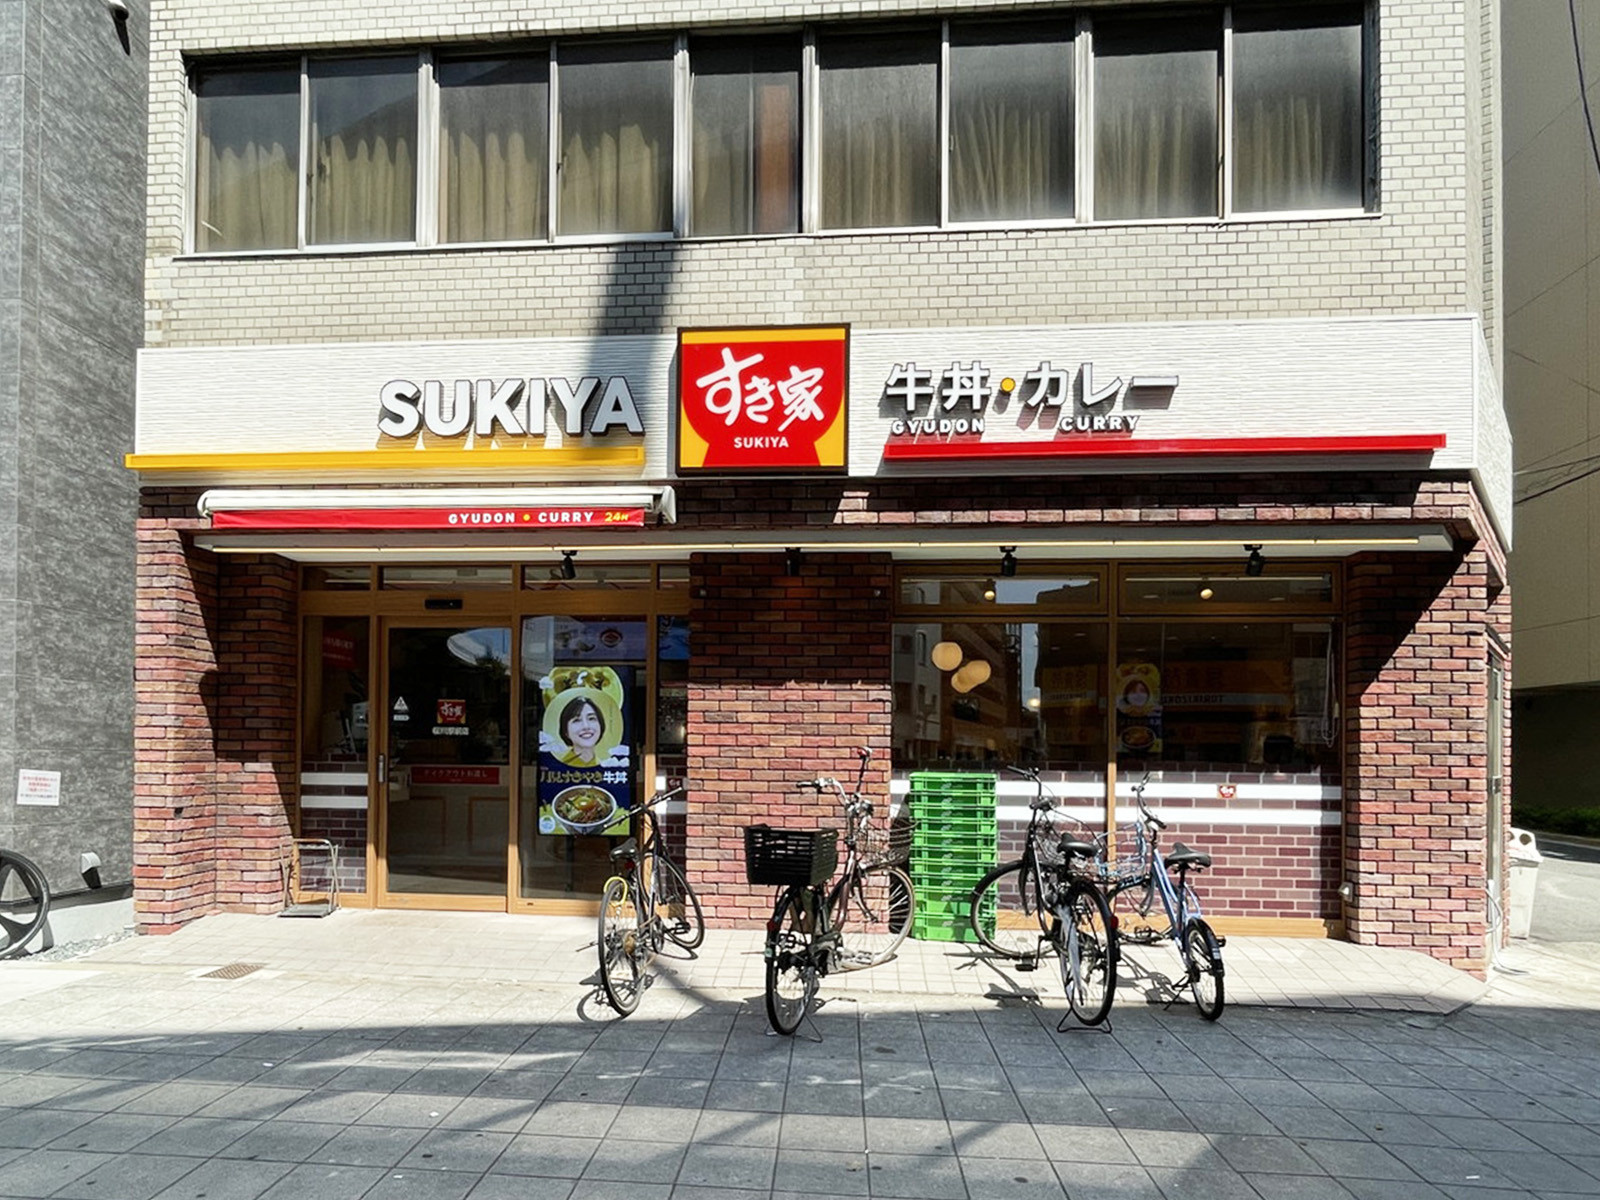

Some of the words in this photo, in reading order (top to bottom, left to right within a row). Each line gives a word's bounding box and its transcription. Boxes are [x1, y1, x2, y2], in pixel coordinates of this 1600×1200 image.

[696, 347, 825, 432] すき家
[378, 376, 645, 438] SUKIYA
[891, 416, 986, 435] GYUDON
[1060, 414, 1141, 432] CURRY
[733, 436, 790, 449] SUKIYA
[448, 512, 516, 524] GYUDON
[538, 511, 595, 523] CURRY
